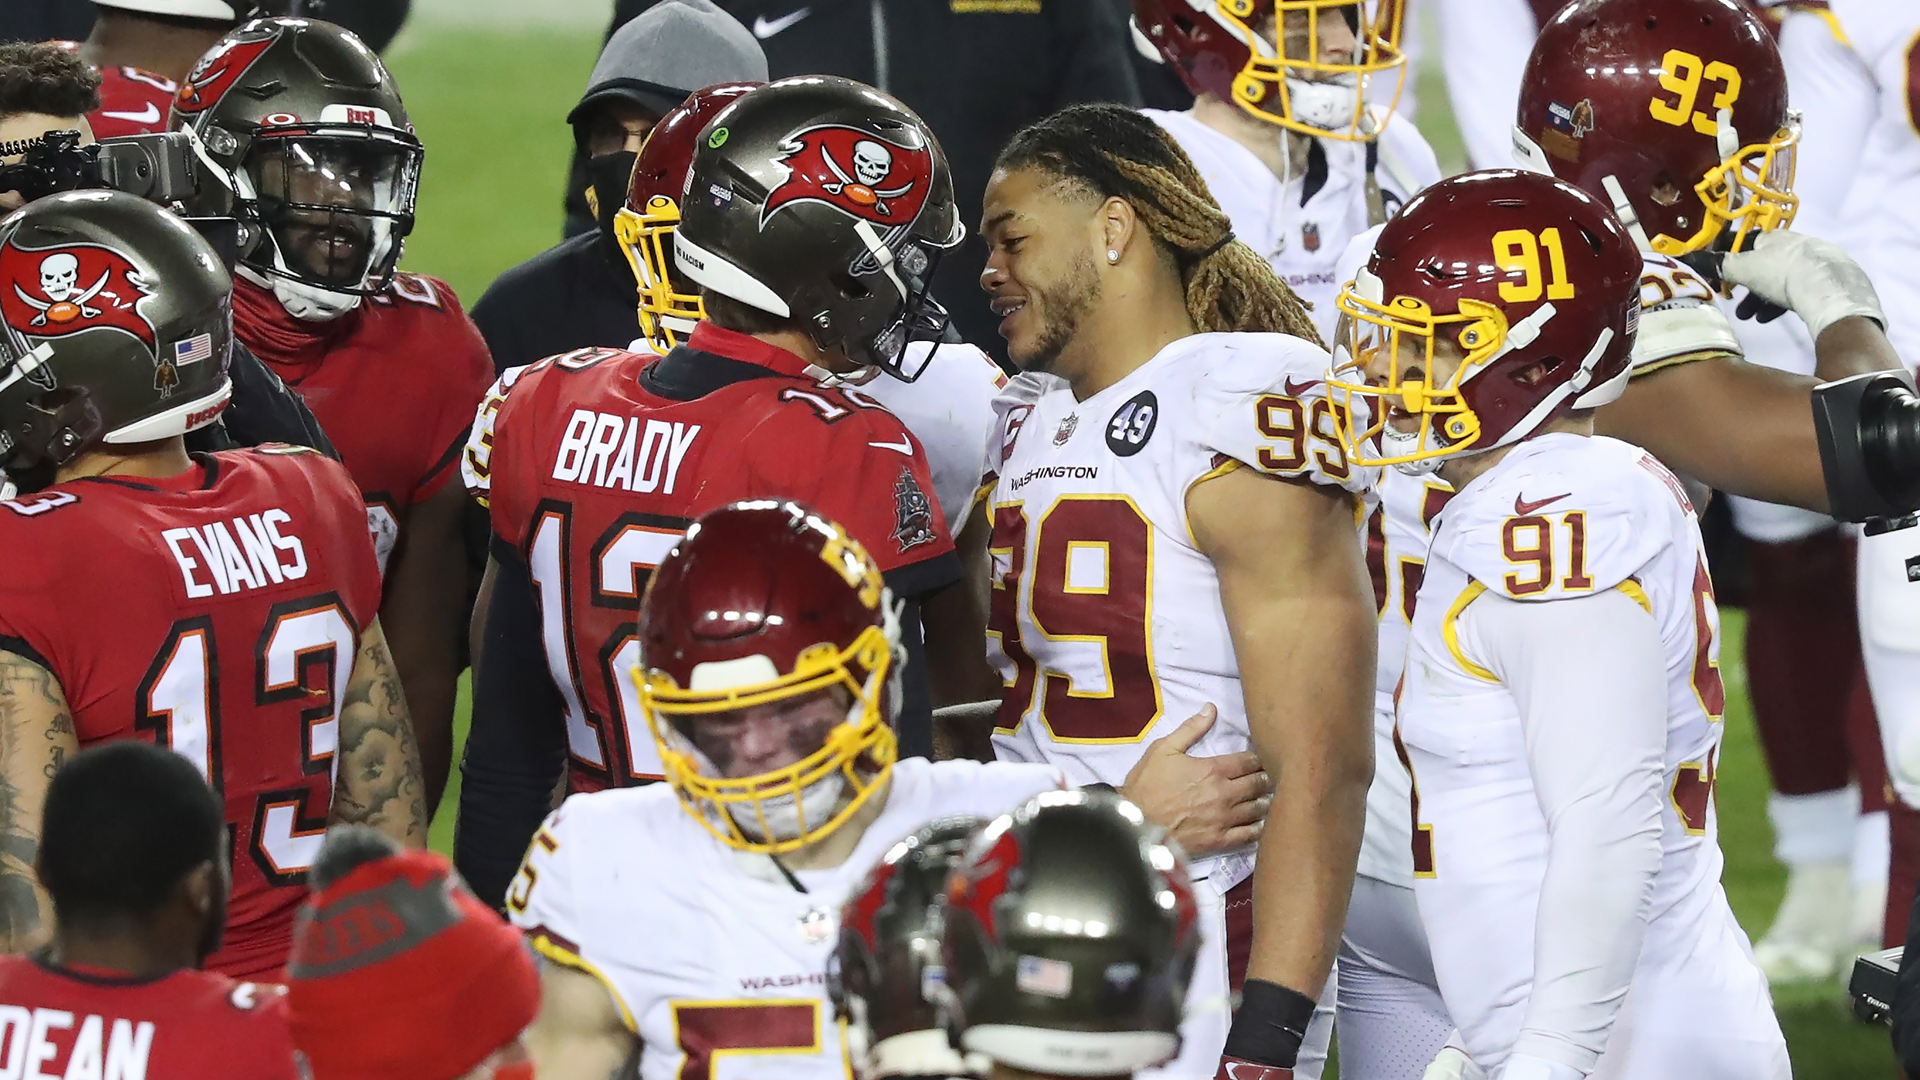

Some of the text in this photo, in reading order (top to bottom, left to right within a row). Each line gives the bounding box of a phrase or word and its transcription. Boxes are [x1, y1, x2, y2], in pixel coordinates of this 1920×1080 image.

[1650, 48, 1741, 136] 93
[1492, 227, 1575, 303] 91
[552, 408, 701, 495] BRADY
[1111, 402, 1154, 445] 49
[1254, 393, 1352, 479] 99
[1010, 465, 1099, 492] WASHINGTON
[162, 507, 309, 599] EVANS
[1500, 511, 1595, 597] 91
[527, 499, 692, 787] 12
[985, 493, 1163, 744] 99
[135, 590, 361, 886] 13
[0, 1004, 156, 1080] DEAN
